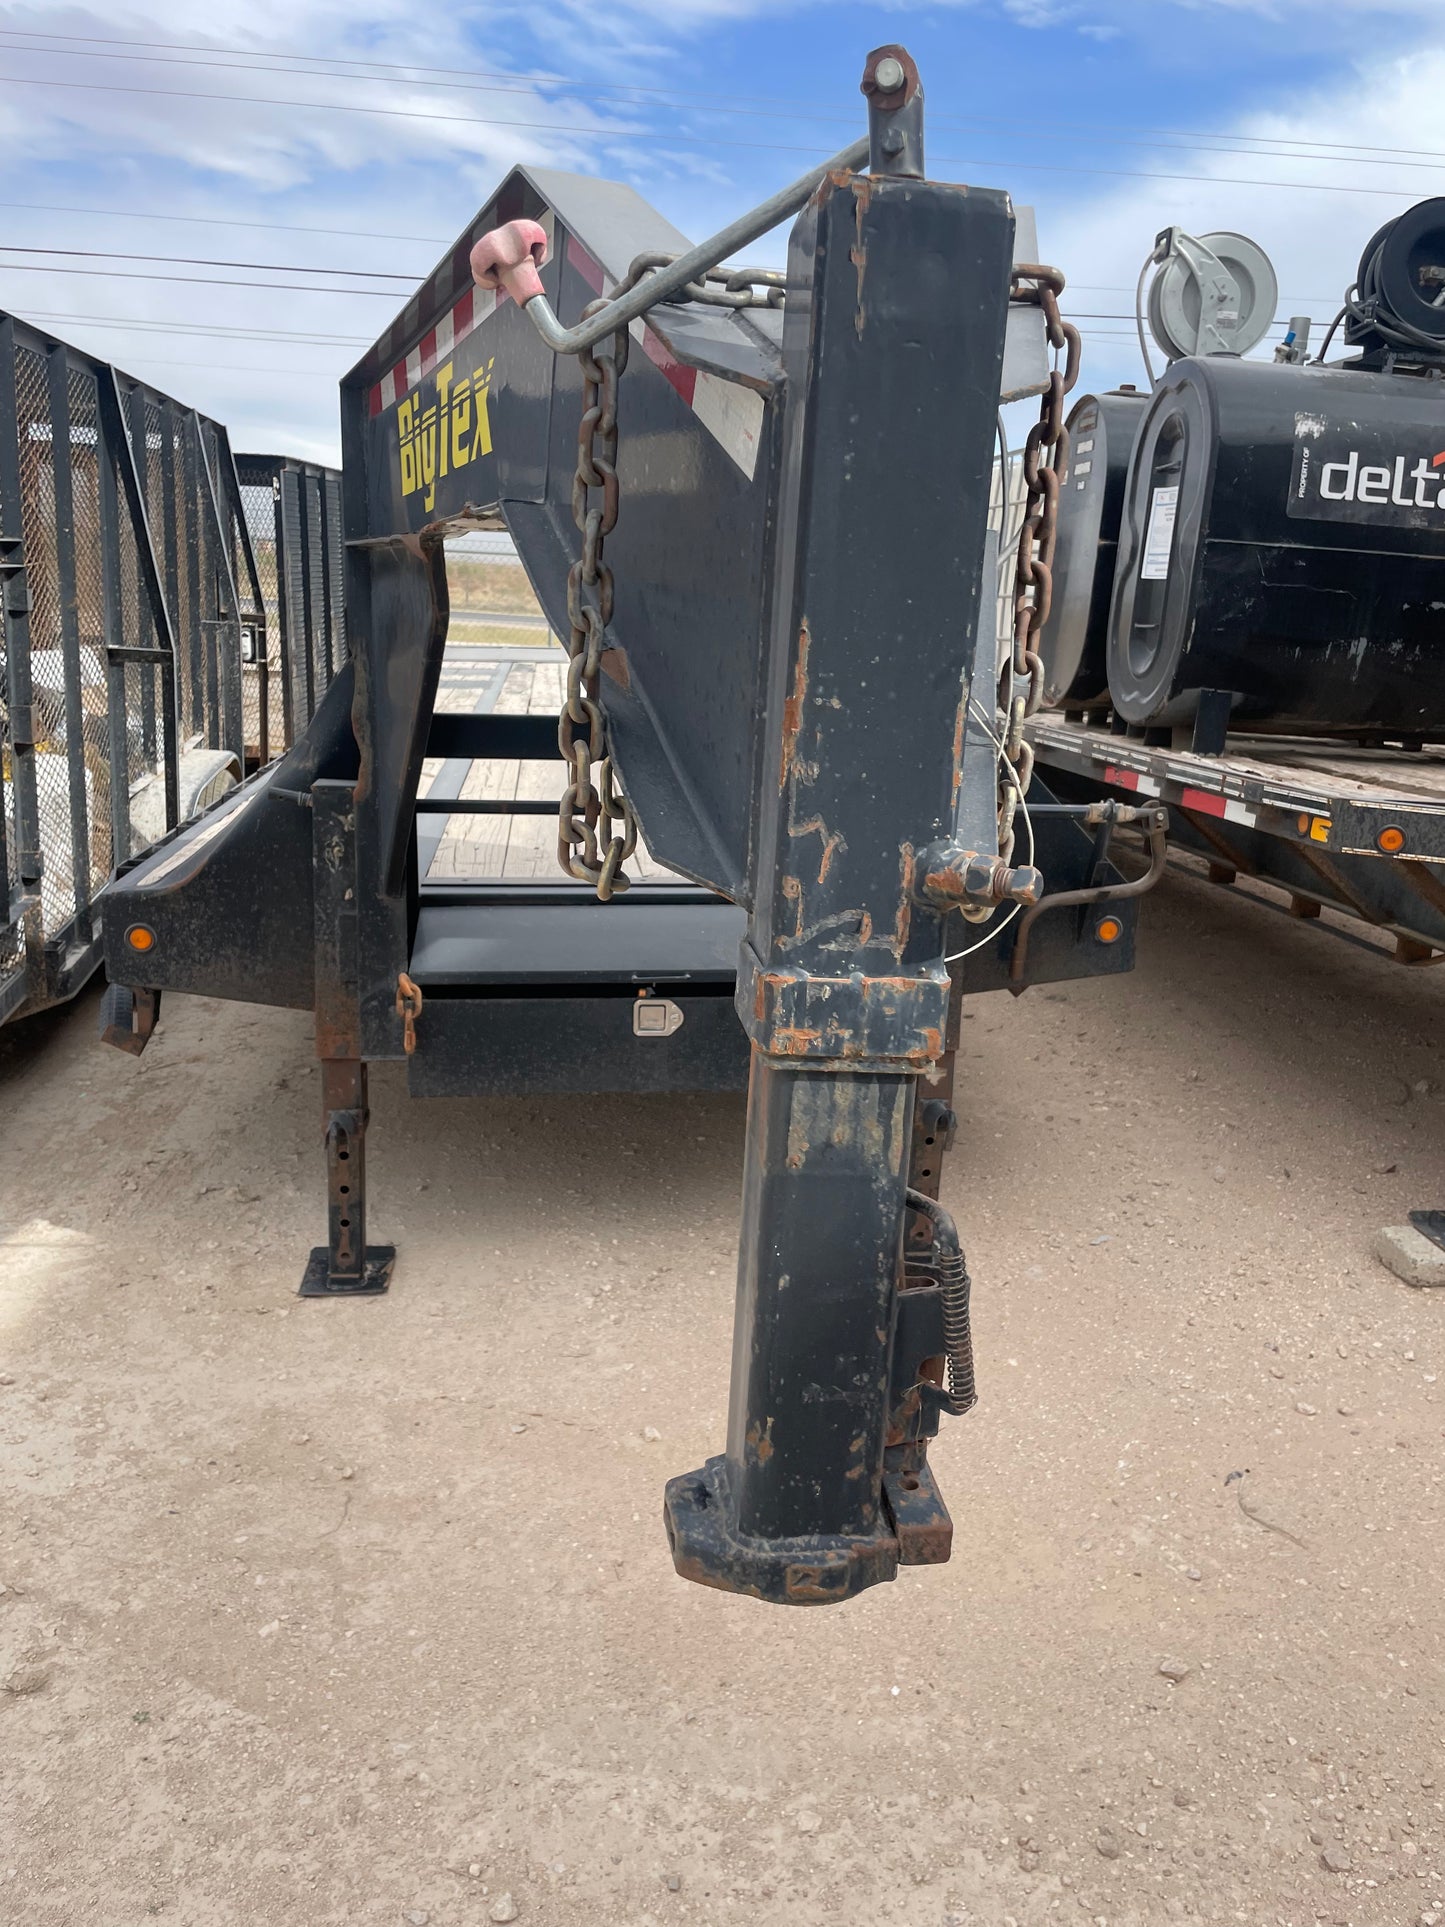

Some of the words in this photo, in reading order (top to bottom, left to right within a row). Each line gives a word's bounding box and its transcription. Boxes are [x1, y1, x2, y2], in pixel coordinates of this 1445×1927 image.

[1303, 446, 1310, 458] OF
[1298, 458, 1309, 498] PROPERTY
[1319, 451, 1445, 510] delt
